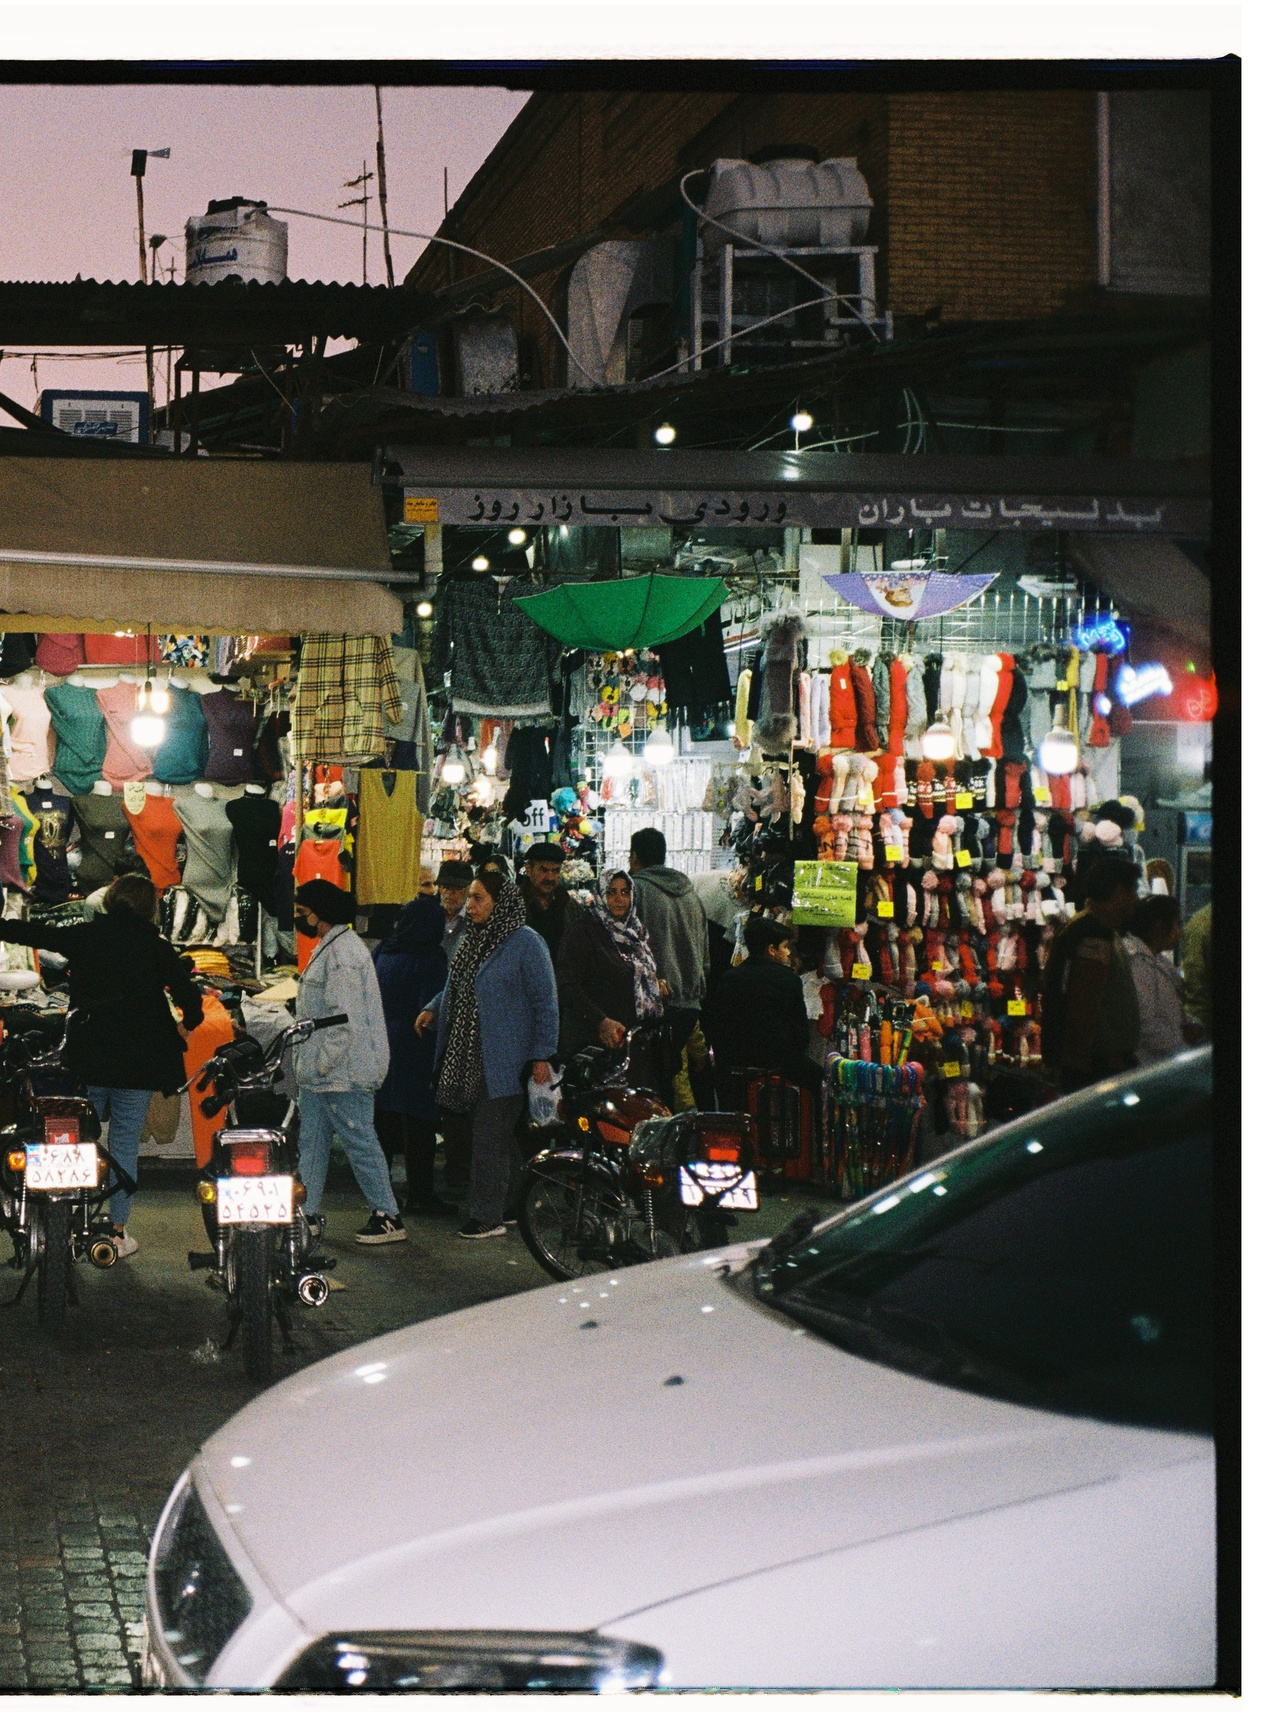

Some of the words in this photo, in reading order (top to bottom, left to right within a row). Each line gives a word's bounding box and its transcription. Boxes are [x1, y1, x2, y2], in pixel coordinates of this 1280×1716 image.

[468, 494, 519, 522] روز
[528, 495, 652, 521] بازار
[659, 496, 787, 525] ورودی
[858, 498, 952, 525] باران
